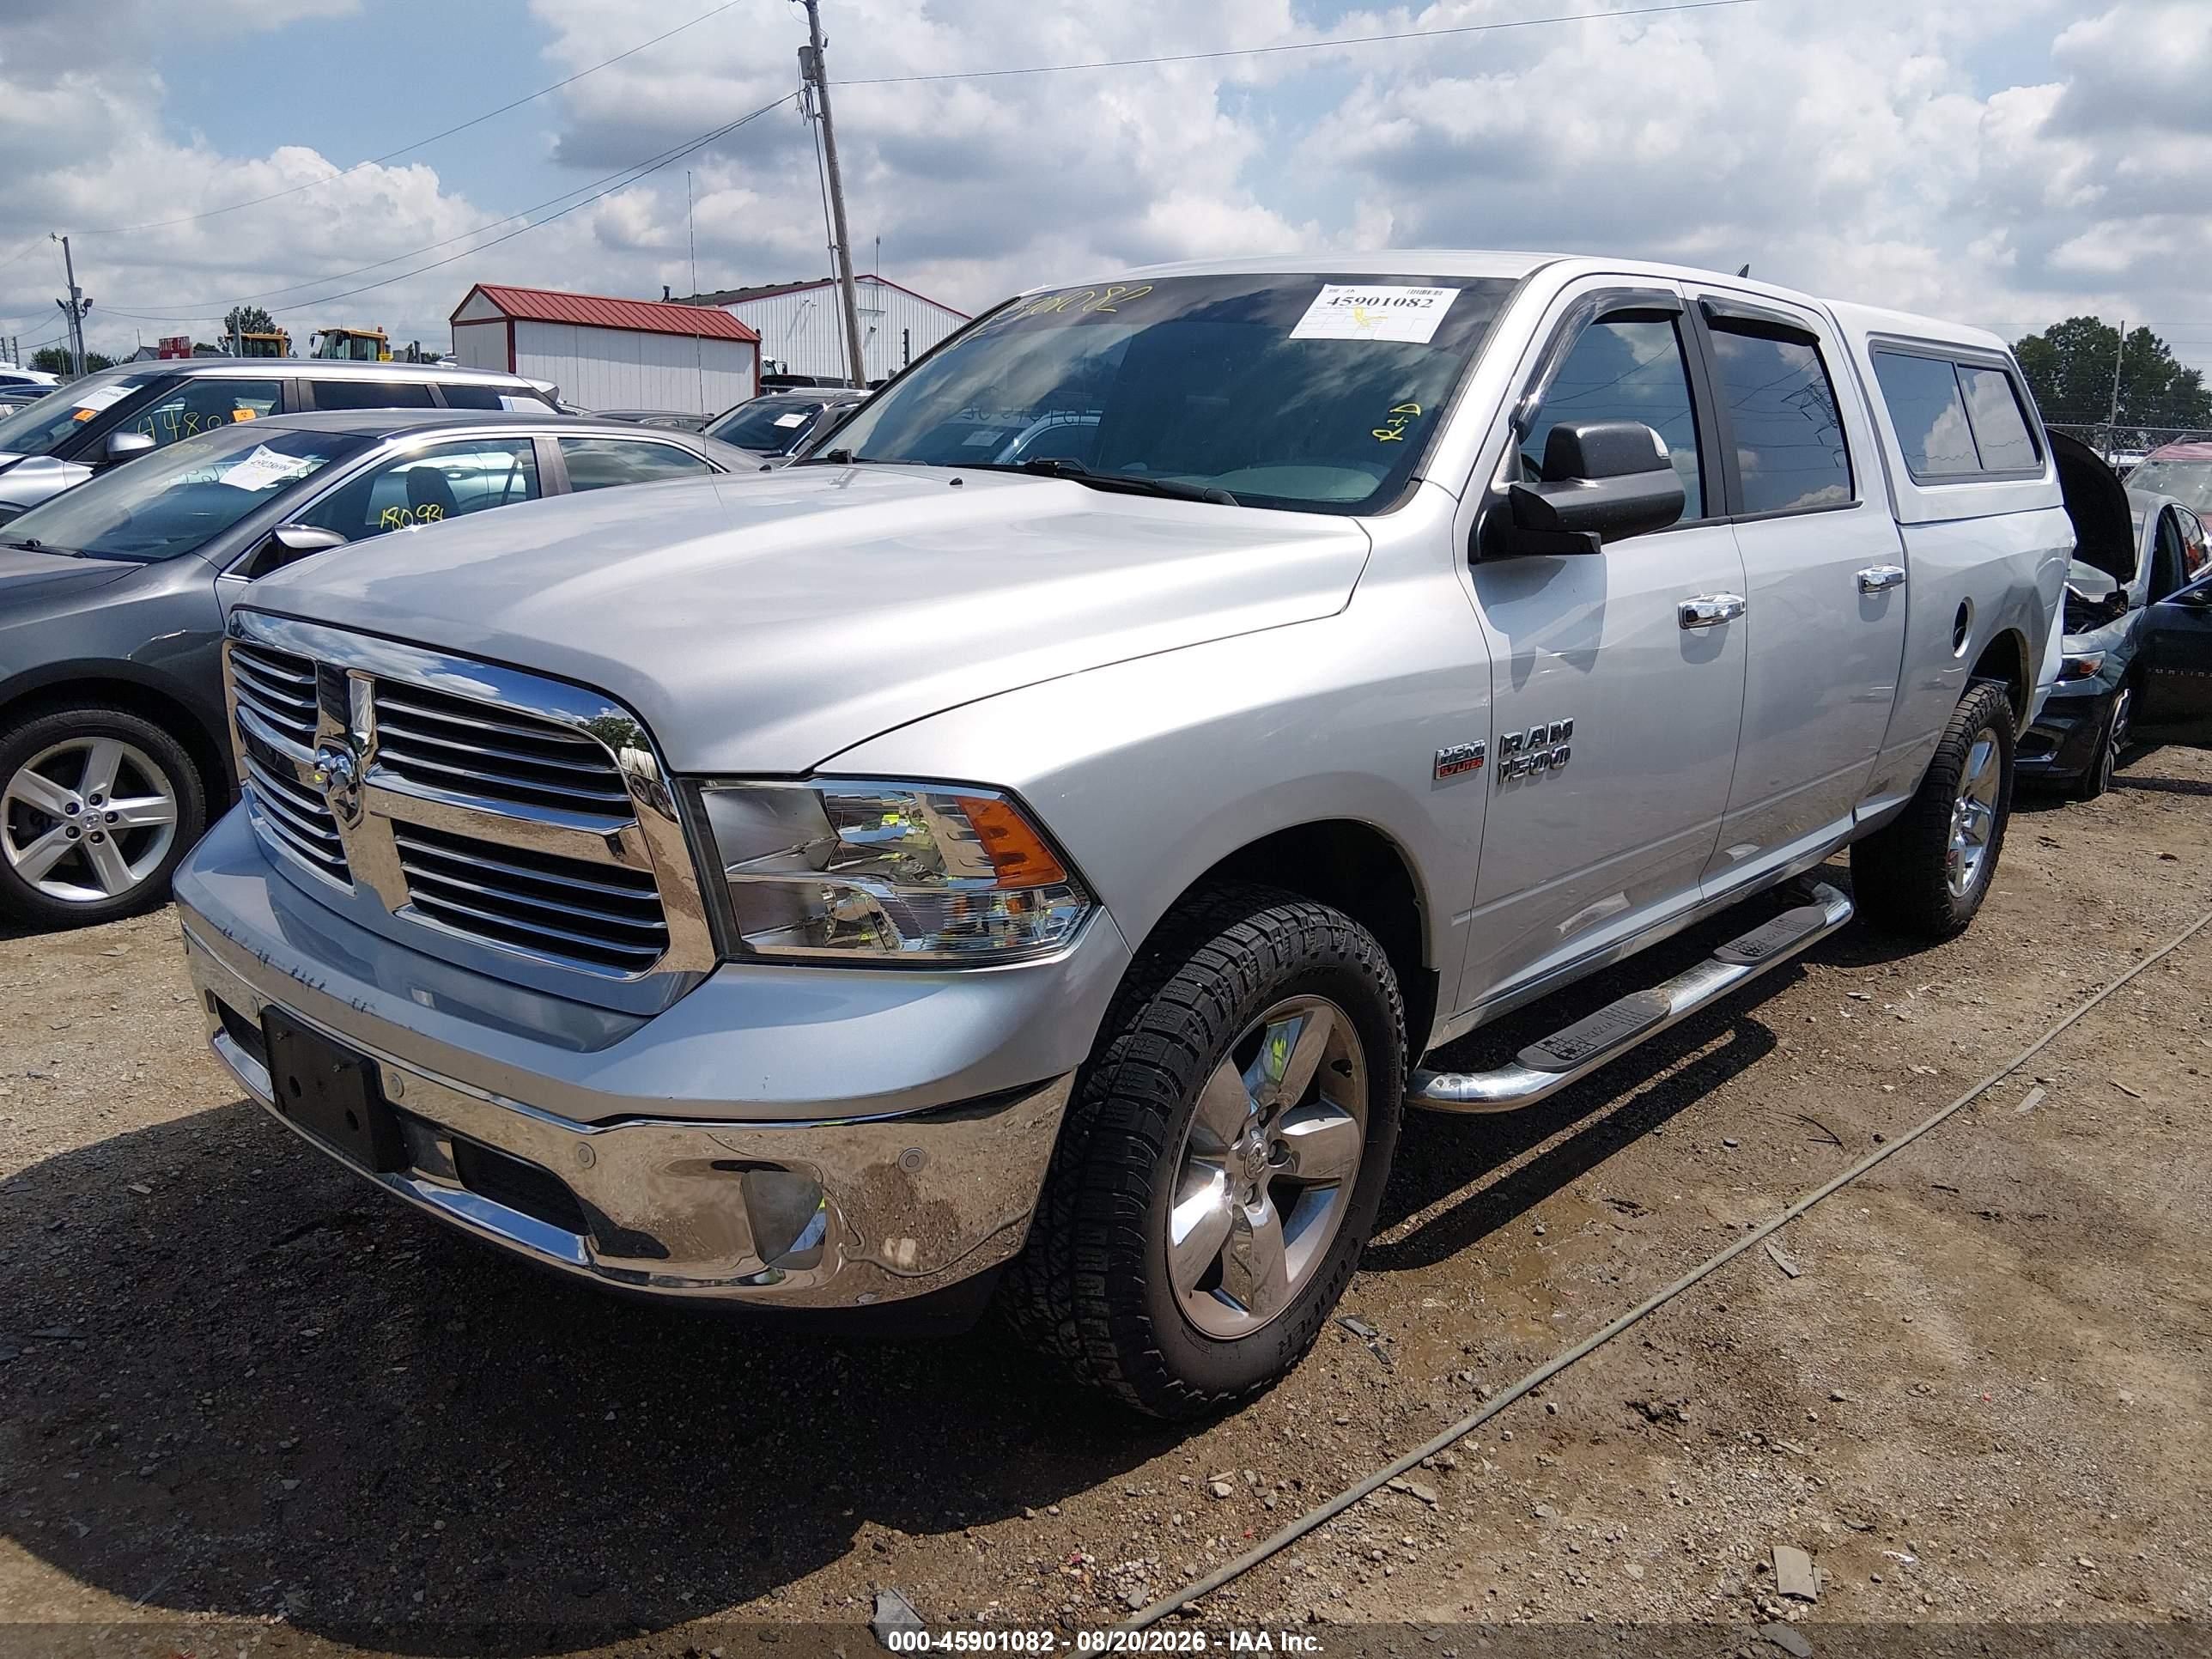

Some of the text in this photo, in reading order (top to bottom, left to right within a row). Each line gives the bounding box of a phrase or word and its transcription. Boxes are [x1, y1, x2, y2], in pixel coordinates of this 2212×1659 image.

[1326, 296, 1434, 308] 45901082
[159, 338, 174, 351] STATE
[1499, 717, 1574, 758] RAM
[1437, 739, 1486, 764] HEMI
[1456, 758, 1483, 772] LITER
[1498, 744, 1571, 785] 1500
